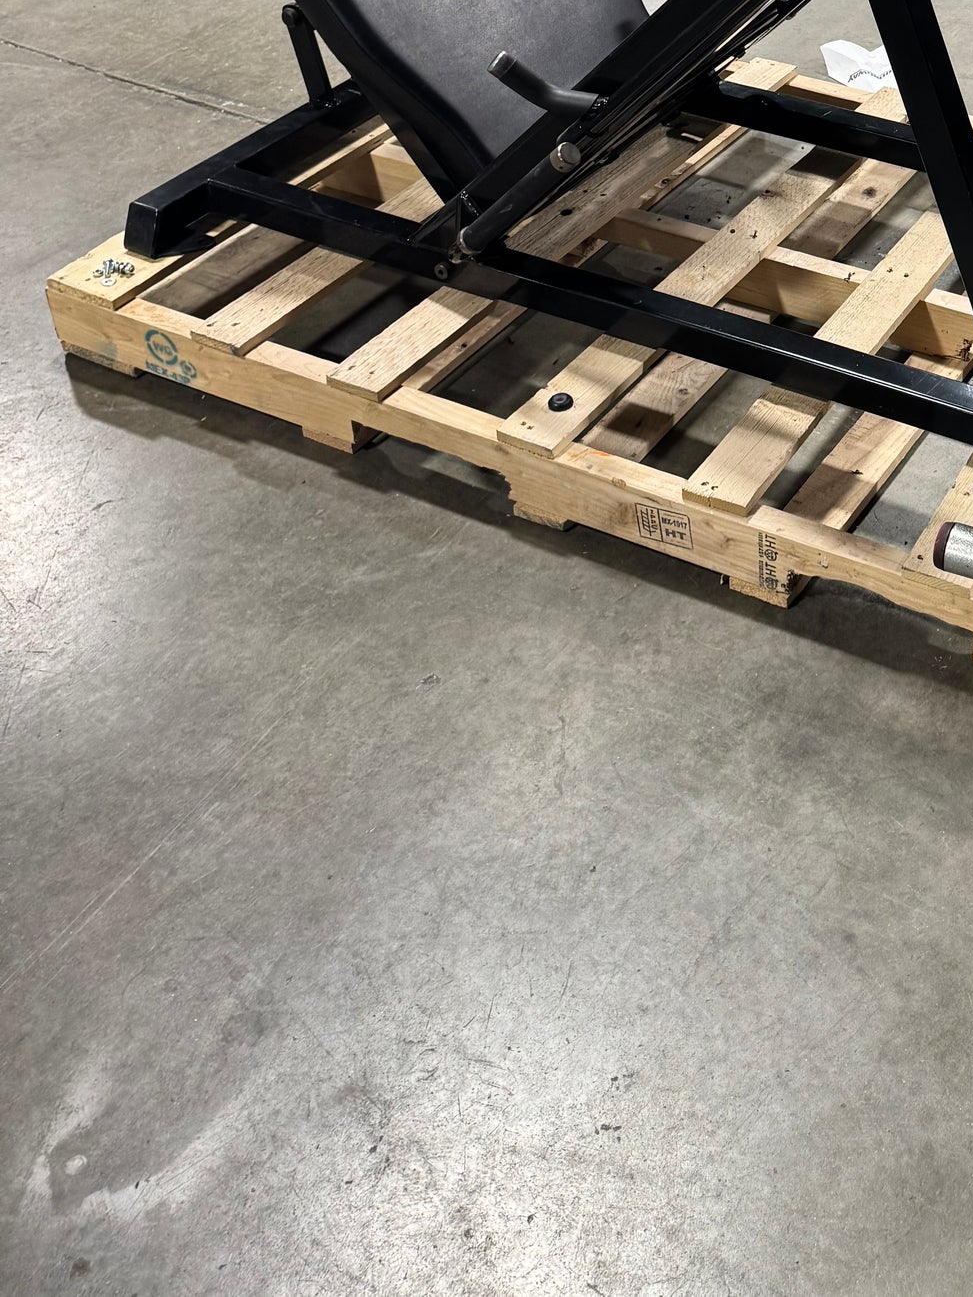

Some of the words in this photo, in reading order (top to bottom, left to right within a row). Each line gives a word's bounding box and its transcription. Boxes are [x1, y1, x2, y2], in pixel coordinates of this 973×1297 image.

[665, 528, 686, 540] HT
[765, 533, 776, 550] HT
[765, 562, 776, 578] HT
